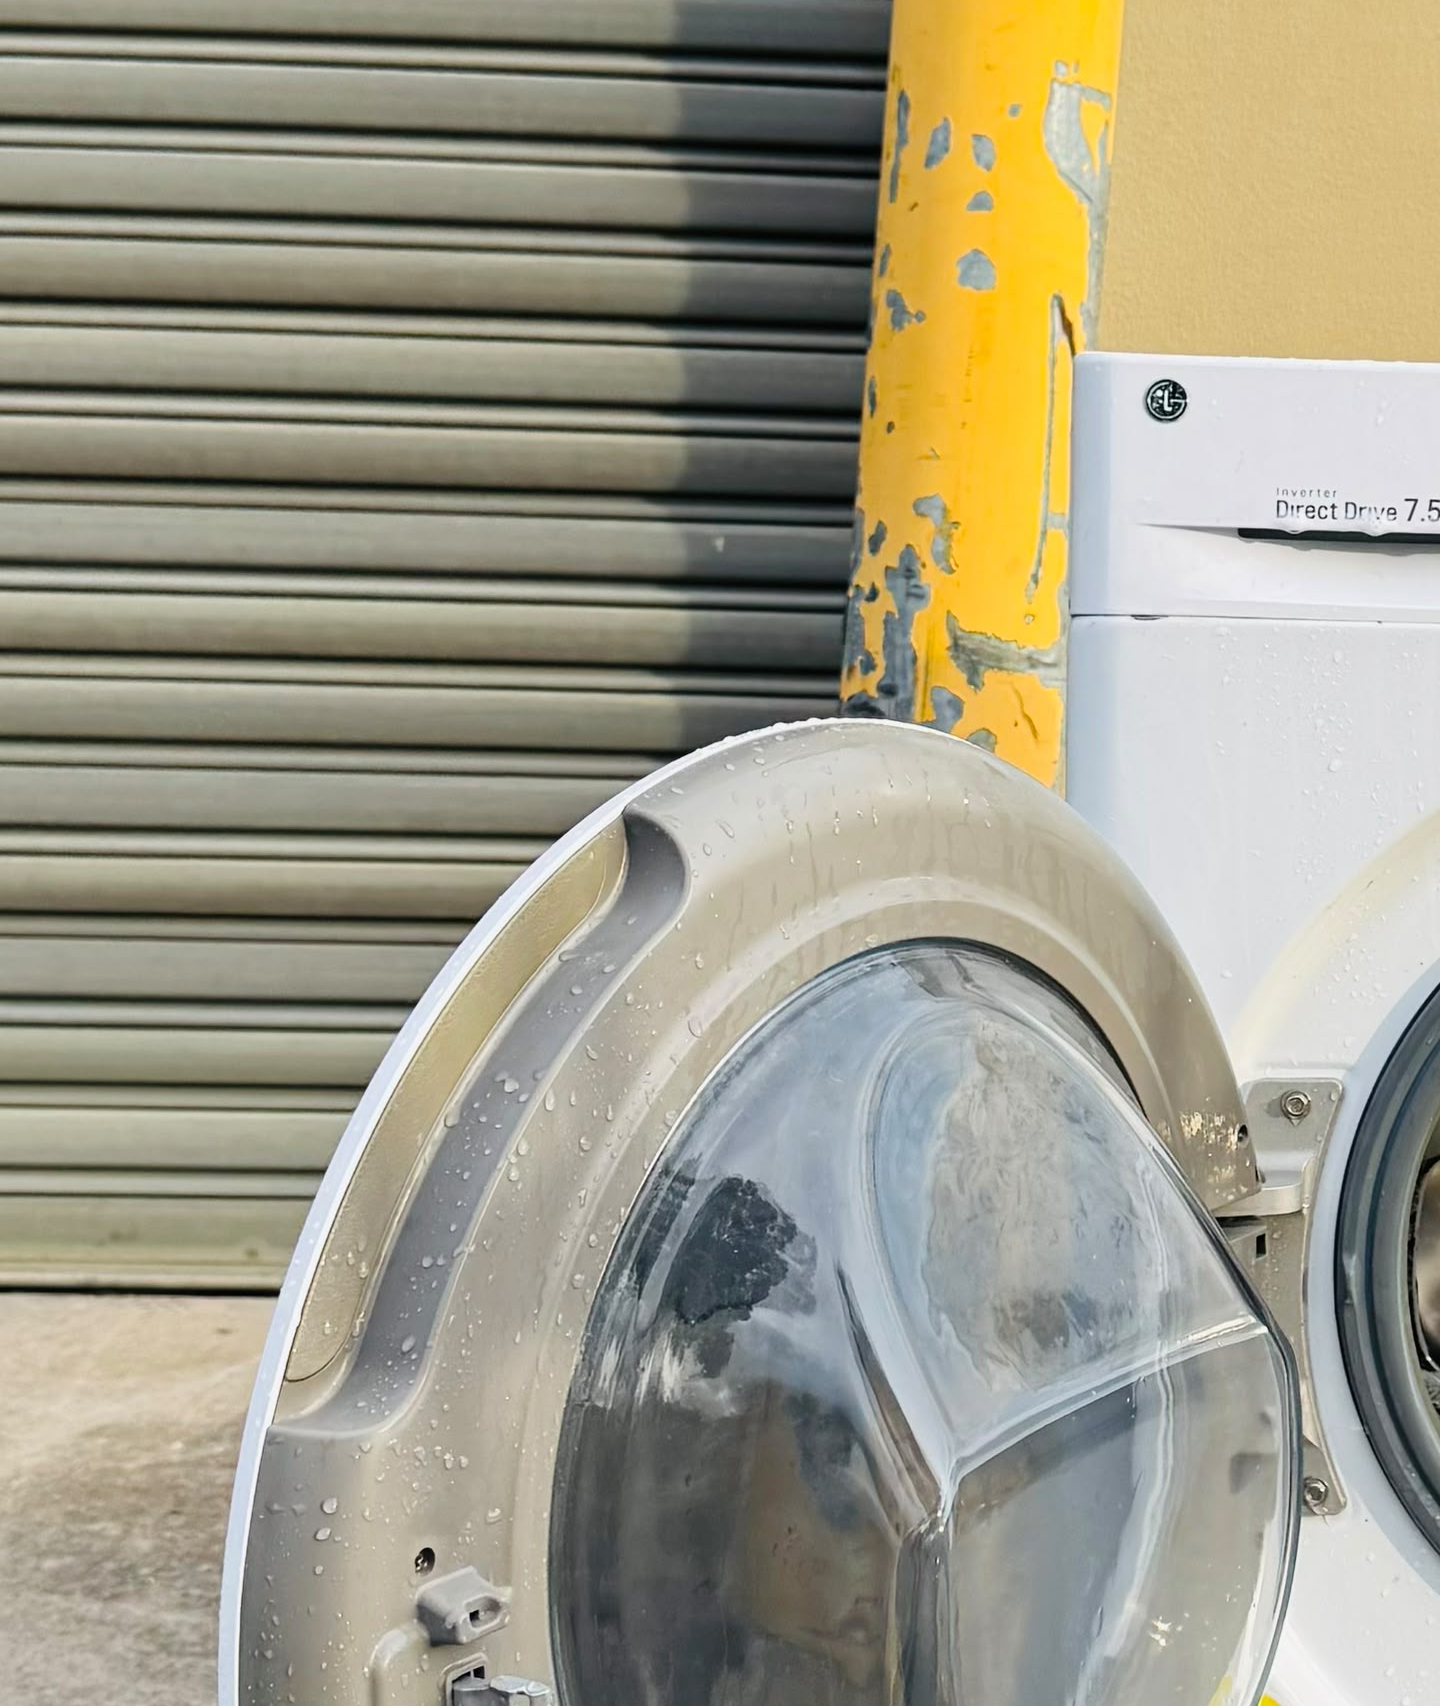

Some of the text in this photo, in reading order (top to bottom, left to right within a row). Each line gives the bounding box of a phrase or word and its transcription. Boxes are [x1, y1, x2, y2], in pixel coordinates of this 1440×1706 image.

[1276, 487, 1338, 498] Inverter
[1276, 499, 1339, 521] Direct
[1344, 501, 1398, 522] Drive
